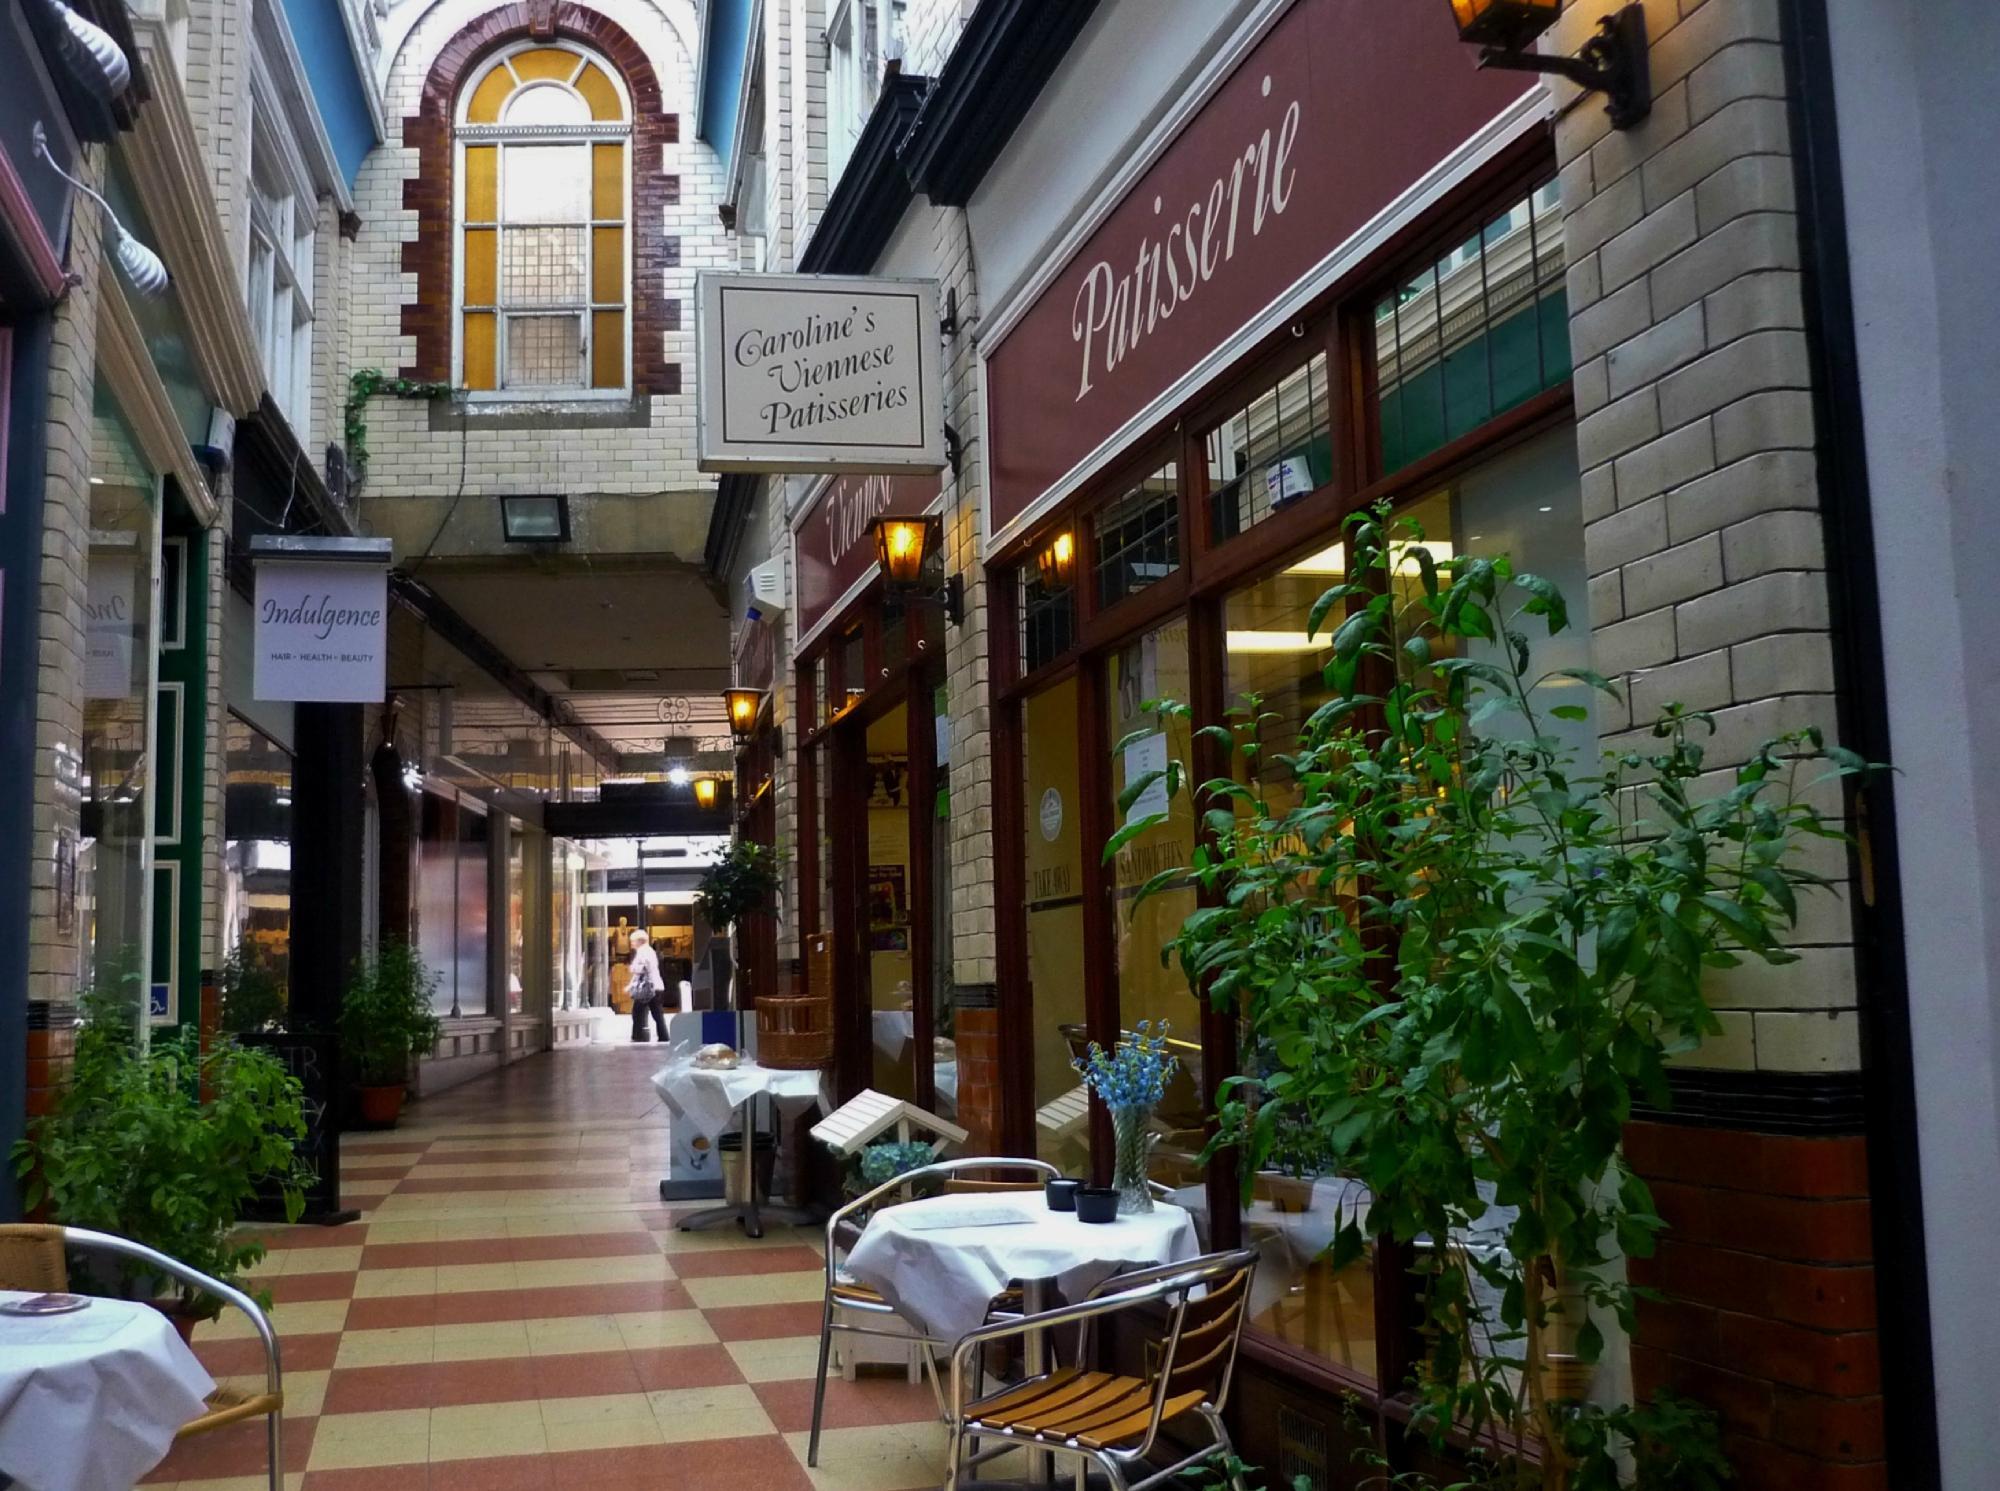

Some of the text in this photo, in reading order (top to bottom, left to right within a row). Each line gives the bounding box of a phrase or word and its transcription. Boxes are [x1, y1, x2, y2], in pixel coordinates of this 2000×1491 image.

[1072, 75, 1299, 402] Patisserie
[734, 305, 876, 367] Caroline's
[767, 344, 894, 393] Viennese
[759, 380, 908, 435] Patisseries
[262, 594, 380, 640] Indulgence
[271, 653, 374, 662] HAIR HEALTH BEAUTY
[1033, 867, 1051, 898] TAKE
[1119, 839, 1184, 882] SANDWICHES
